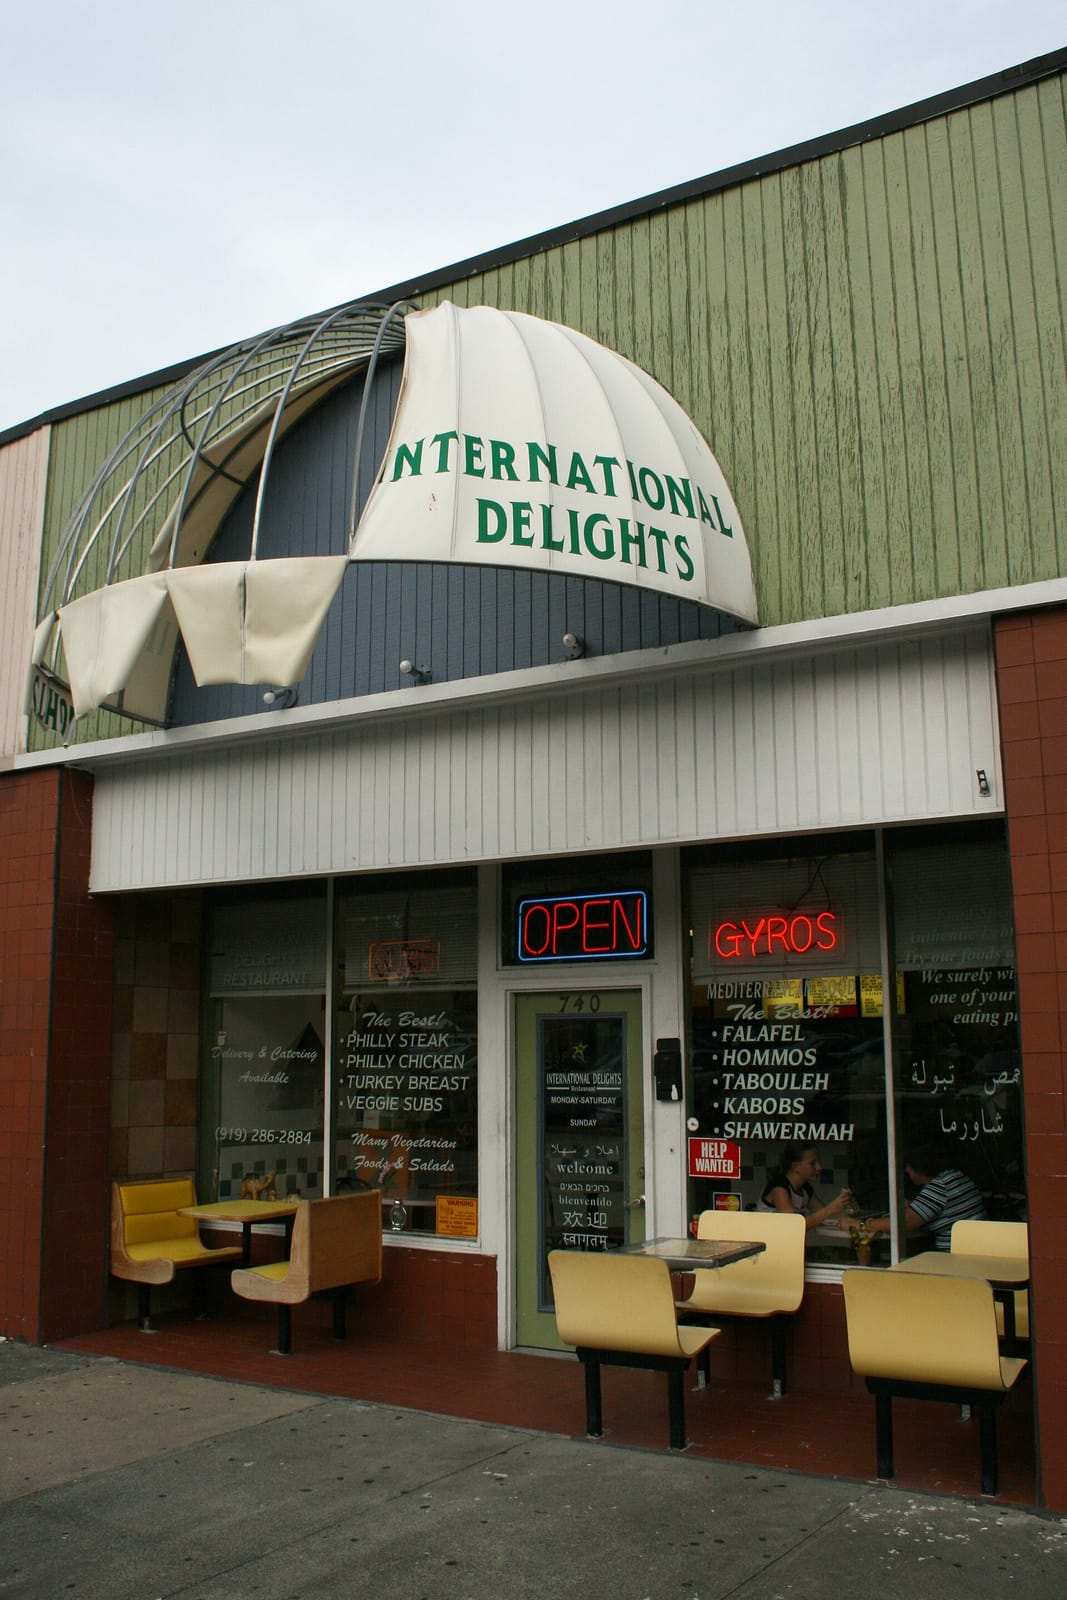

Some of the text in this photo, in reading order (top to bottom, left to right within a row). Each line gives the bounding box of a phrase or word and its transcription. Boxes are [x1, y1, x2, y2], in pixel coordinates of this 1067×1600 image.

[378, 430, 733, 540] NTERNATIONAL
[475, 497, 695, 582] DELIGHTS
[523, 898, 642, 955] OPEN
[715, 912, 836, 958] GYROS
[223, 970, 308, 986] RESTAURANT
[921, 969, 943, 984] We
[946, 967, 993, 985] surely
[706, 979, 812, 1000] MEDITERRANEAN
[817, 977, 856, 998] FOOD
[929, 988, 1016, 1006] one of your
[559, 993, 601, 1013] 740
[726, 1002, 833, 1022] The Best!
[362, 1010, 447, 1028] The Best!
[953, 1009, 1000, 1027] eating
[346, 1033, 449, 1048] PHILLY STEAK
[722, 1024, 806, 1042] FALAFEL
[210, 1045, 318, 1063] Delivery & Catering
[346, 1054, 466, 1070] PHILLY CHICKEN
[722, 1048, 817, 1066] HOMMOS
[238, 1070, 289, 1084] Available
[346, 1074, 470, 1091] TURKEY BREAST
[546, 1072, 622, 1085] INTERNATIONAL DELIGHTS
[722, 1073, 829, 1091] TABOULEH
[911, 1059, 955, 1094] تبولة
[346, 1095, 444, 1112] VEGGIE SUBS
[551, 1096, 617, 1105] MONDAY-SATURDAY
[723, 1097, 805, 1115] KABOBS
[570, 1119, 598, 1127] SUNDAY
[723, 1121, 855, 1141] SHAWERMAH
[939, 1107, 1004, 1142] شاورما
[214, 1126, 312, 1145] (919) 286-2884
[351, 1132, 457, 1152] Many Vegetarian
[701, 1141, 728, 1158] HELP
[352, 1155, 456, 1172] Foods & Salads
[557, 1161, 614, 1175] welcome
[695, 1158, 734, 1174] WANTED
[558, 1194, 612, 1207] bienvenido
[562, 1210, 608, 1229] 欢迎
